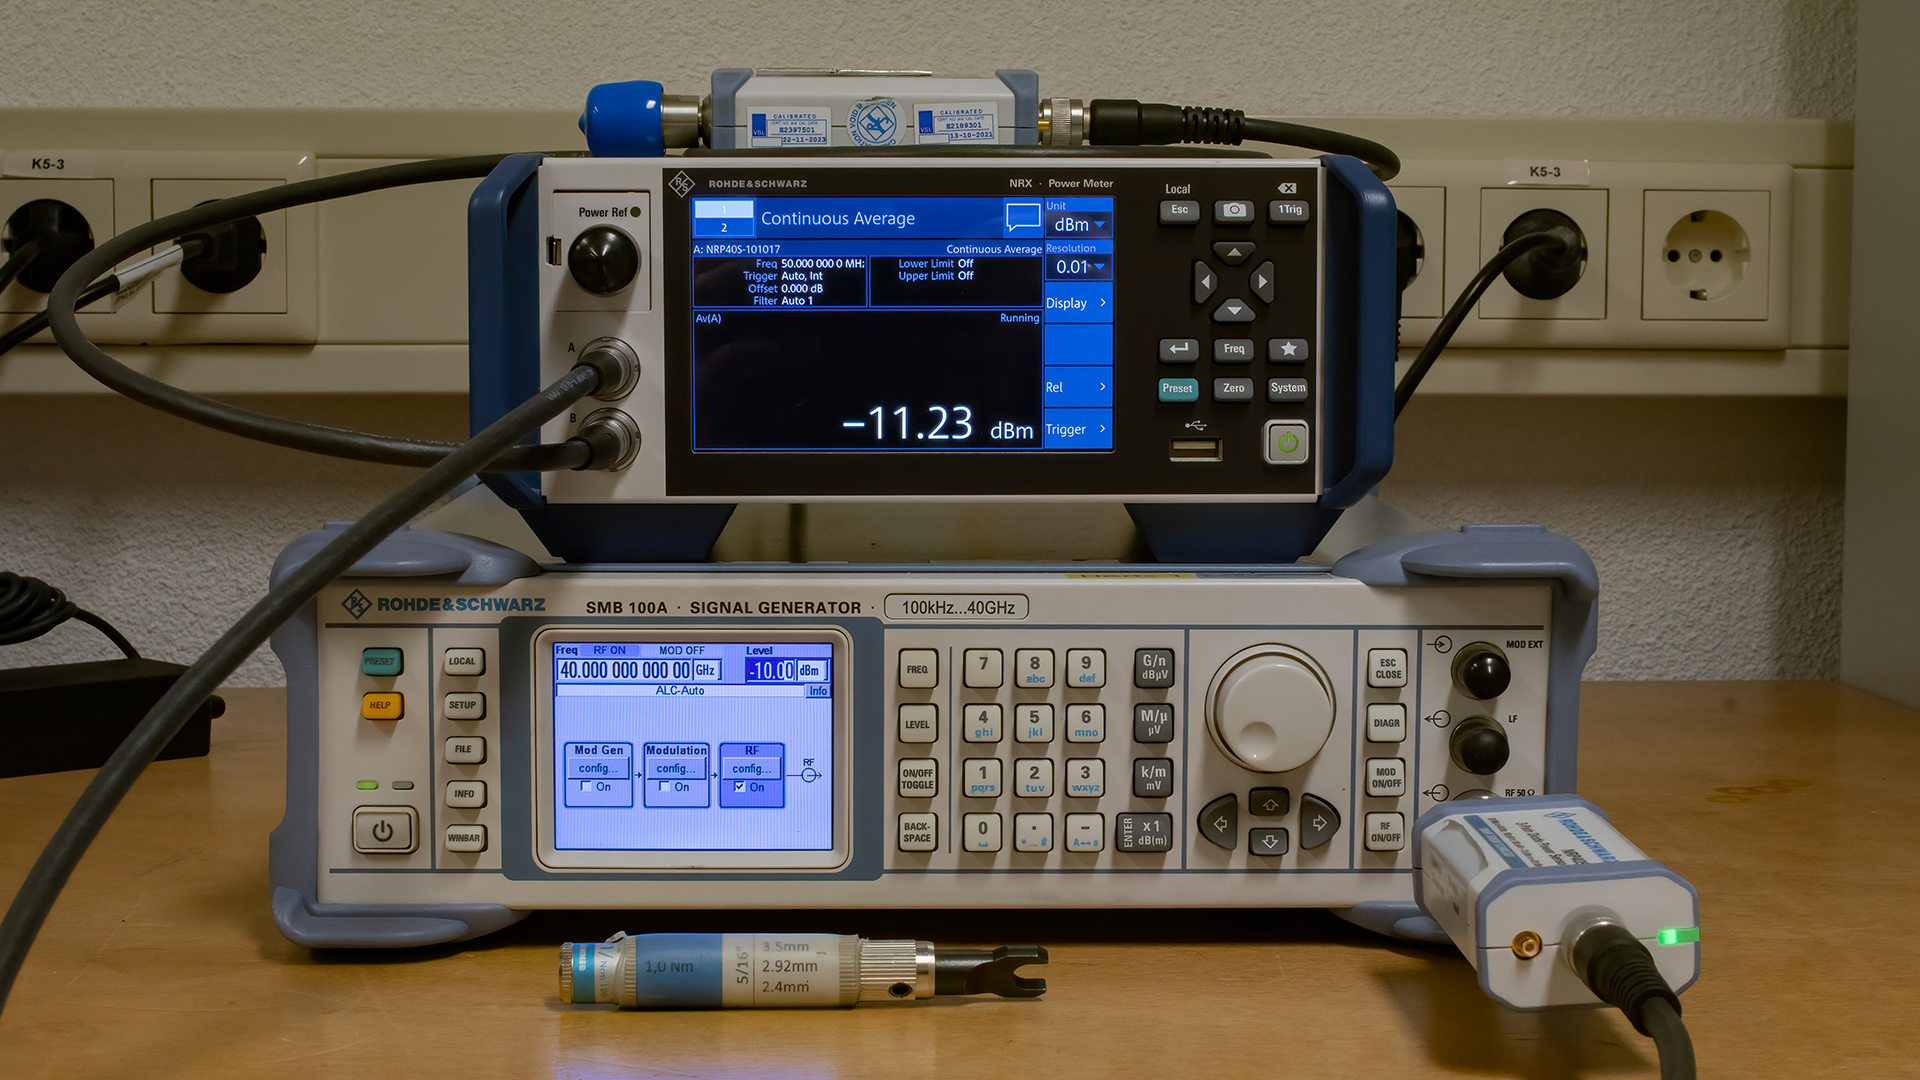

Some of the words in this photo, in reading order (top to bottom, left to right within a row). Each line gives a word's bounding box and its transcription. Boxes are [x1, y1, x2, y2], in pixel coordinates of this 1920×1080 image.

[31, 158, 65, 171] K5-3
[1529, 165, 1562, 178] K5-3
[708, 180, 808, 188] ROHDE&SCHWARZ
[1010, 179, 1032, 188] NRX
[1048, 179, 1080, 188] Power
[1083, 179, 1114, 188] Meter
[1166, 184, 1191, 194] Local
[1046, 202, 1066, 210] Unit
[1172, 205, 1188, 214] Esc
[1278, 204, 1302, 216] 1Trig
[579, 207, 609, 218] Power
[612, 207, 627, 217] Ref
[761, 211, 850, 227] Continuous
[854, 211, 916, 230] Average
[1054, 217, 1089, 233] dBm
[693, 245, 703, 254] A:
[706, 244, 781, 254] NRP40S-101017
[946, 245, 1001, 254] Continuous
[1004, 245, 1042, 256] Average
[1046, 244, 1096, 253] Resolution
[756, 259, 778, 270] Freq
[781, 259, 814, 268] 50.000
[816, 259, 834, 268] 000
[836, 259, 843, 268] 0
[898, 259, 925, 268] Lower
[927, 259, 954, 268] Limit
[958, 259, 974, 268] Off
[1056, 259, 1089, 275] 0.01
[743, 271, 778, 282] Trigger
[781, 271, 808, 282] Auto,
[810, 271, 823, 280] Int
[898, 271, 925, 282] Upper
[927, 271, 954, 281] Limit
[958, 271, 974, 281] Off
[748, 284, 778, 293] Offset
[781, 284, 808, 293] 0.000
[810, 284, 823, 293] dB
[754, 296, 778, 305] Filter
[781, 296, 805, 305] Auto
[808, 296, 813, 305] 1
[1046, 296, 1088, 311] Display
[696, 313, 722, 324] Av(A)
[1000, 313, 1040, 325] Running
[568, 342, 576, 352] A
[1224, 344, 1245, 355] Freq
[1046, 381, 1063, 393] Rel
[1163, 384, 1193, 393] Preset
[1223, 383, 1245, 393] Zero
[1271, 383, 1306, 395] System
[570, 413, 576, 423] B
[989, 422, 1034, 440] dBm
[1046, 423, 1087, 437] Trigger
[377, 597, 546, 612] ROHDE&SCHWARZ
[585, 601, 624, 614] SMB
[628, 601, 668, 614] 100A
[689, 601, 754, 615] SIGNAL
[757, 601, 862, 615] GENERATOR
[556, 646, 578, 656] Freq
[593, 646, 607, 655] RF
[610, 646, 626, 655] ON
[660, 646, 680, 655] MOD
[682, 646, 704, 655] OFF
[746, 646, 772, 655] Level
[364, 658, 395, 666] PRESET
[1030, 656, 1040, 670] 8
[1142, 654, 1166, 668] G/n
[1380, 659, 1396, 667] ESC
[560, 661, 609, 679] 40.000
[611, 661, 639, 679] 000
[642, 661, 670, 679] 000
[673, 661, 691, 679] 00
[696, 665, 715, 676] GHz
[749, 662, 793, 679] -10.00
[800, 665, 819, 676] dBm
[906, 666, 928, 674] FREQ
[1376, 671, 1401, 679] CLOSE
[1026, 674, 1046, 684] abc
[1079, 674, 1096, 684] def
[656, 686, 705, 695] ALC-Auto
[810, 686, 827, 696] Info
[978, 710, 989, 724] 4
[905, 720, 930, 729] LEVEL
[1374, 719, 1400, 727] DIAGR
[975, 728, 993, 738] ghi
[1028, 727, 1043, 738] jkl
[1074, 728, 1098, 737] mno
[574, 746, 597, 754] Mod
[601, 746, 623, 754] Gen
[646, 746, 707, 754] Modulation
[746, 746, 759, 754] RF
[579, 764, 618, 775] config...
[903, 769, 933, 778] ON/OFF
[1141, 765, 1167, 779] k/m
[1377, 768, 1396, 776] MOD
[596, 782, 611, 791] On
[902, 780, 933, 790] TOGGLE
[971, 784, 995, 794] pqrs
[1026, 784, 1045, 792] tuv
[1072, 784, 1100, 794] wxyz
[1146, 780, 1162, 790] mV
[1372, 780, 1401, 788] ON/OFF
[1505, 789, 1516, 797] RF
[1517, 789, 1526, 797] 50
[904, 822, 930, 831] BACK-
[448, 834, 480, 842] WINBAR
[904, 834, 931, 842] SPACE
[1123, 818, 1133, 848] ENTER
[1138, 835, 1167, 846] dB(m)
[762, 941, 809, 952] 3.5mm
[646, 960, 667, 975] 1,0
[671, 961, 693, 972] Nm
[762, 960, 818, 973] 2.92mm
[762, 981, 809, 992] 2.4mm
